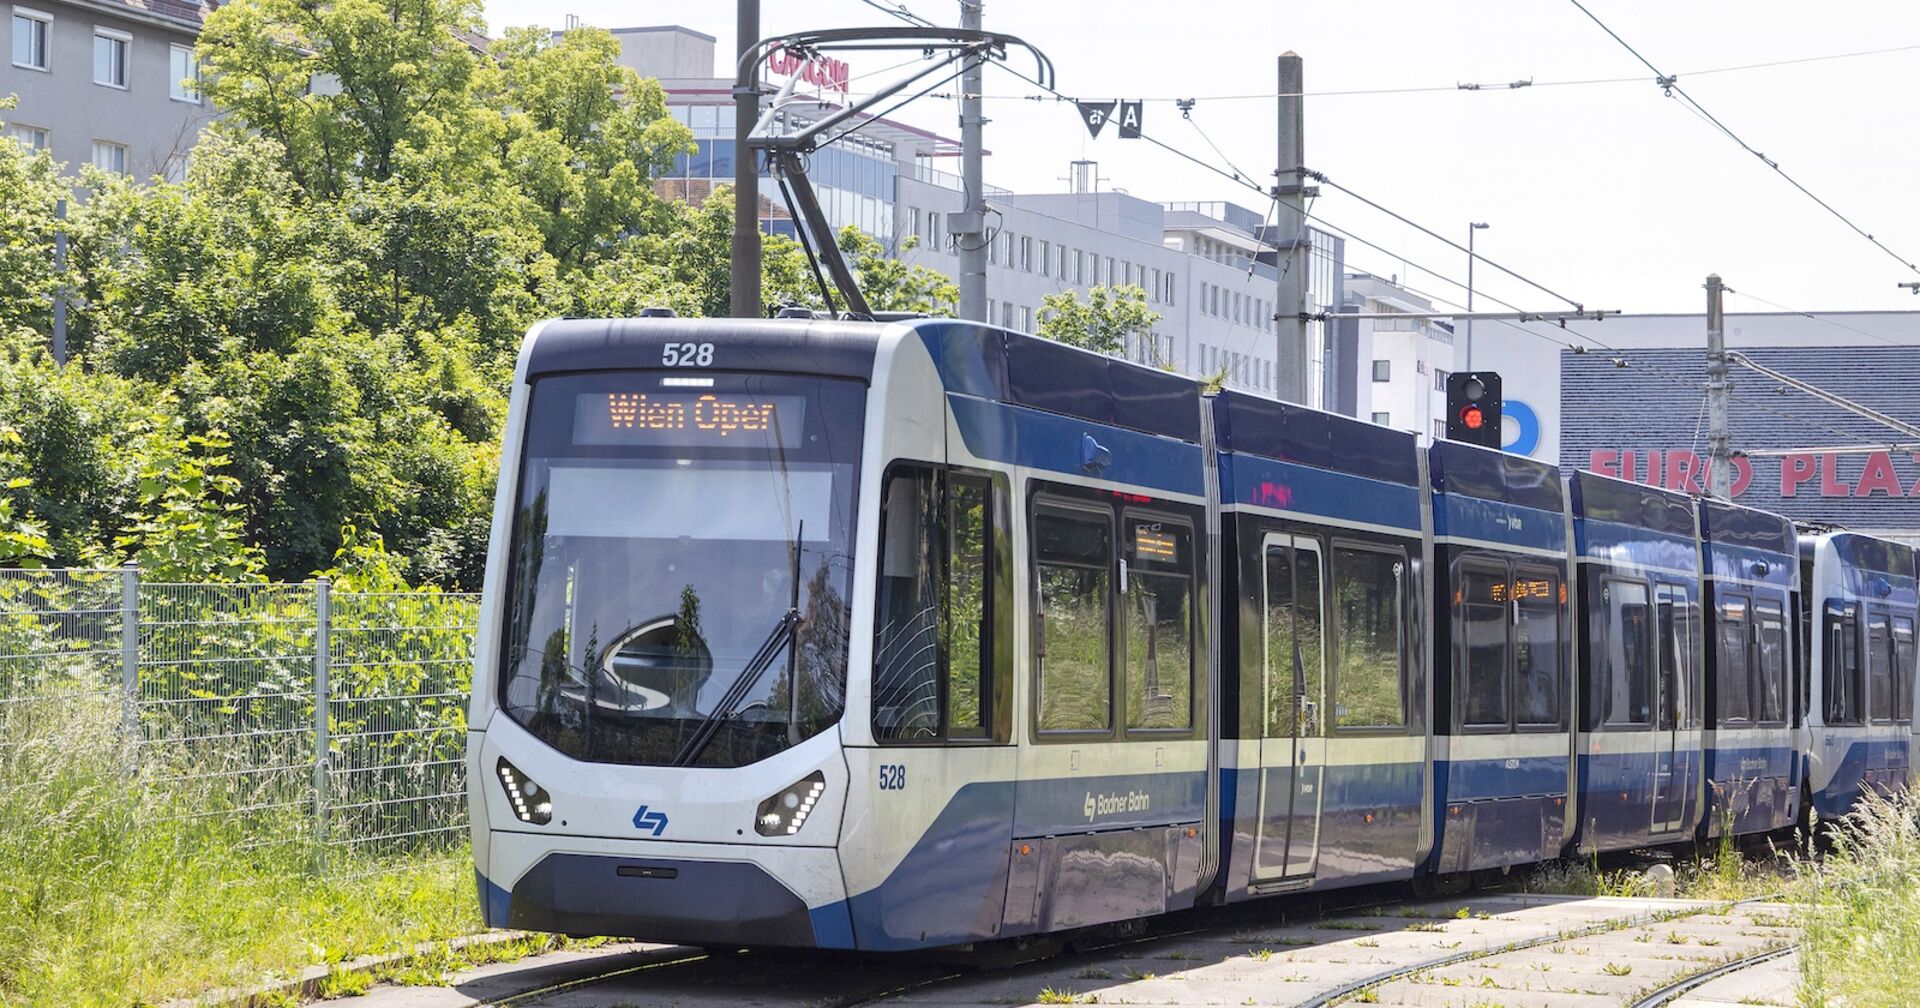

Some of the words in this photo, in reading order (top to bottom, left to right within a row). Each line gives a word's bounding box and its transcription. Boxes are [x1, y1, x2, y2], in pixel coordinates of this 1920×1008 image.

[1123, 105, 1138, 128] A
[661, 342, 714, 367] 528
[609, 393, 685, 429] Wien
[694, 394, 774, 437] Oper
[1589, 449, 1754, 498] EURO
[1780, 450, 1920, 498] PLA
[879, 764, 906, 791] 528
[1097, 792, 1128, 815] Badner
[1128, 790, 1149, 813] Bahn
